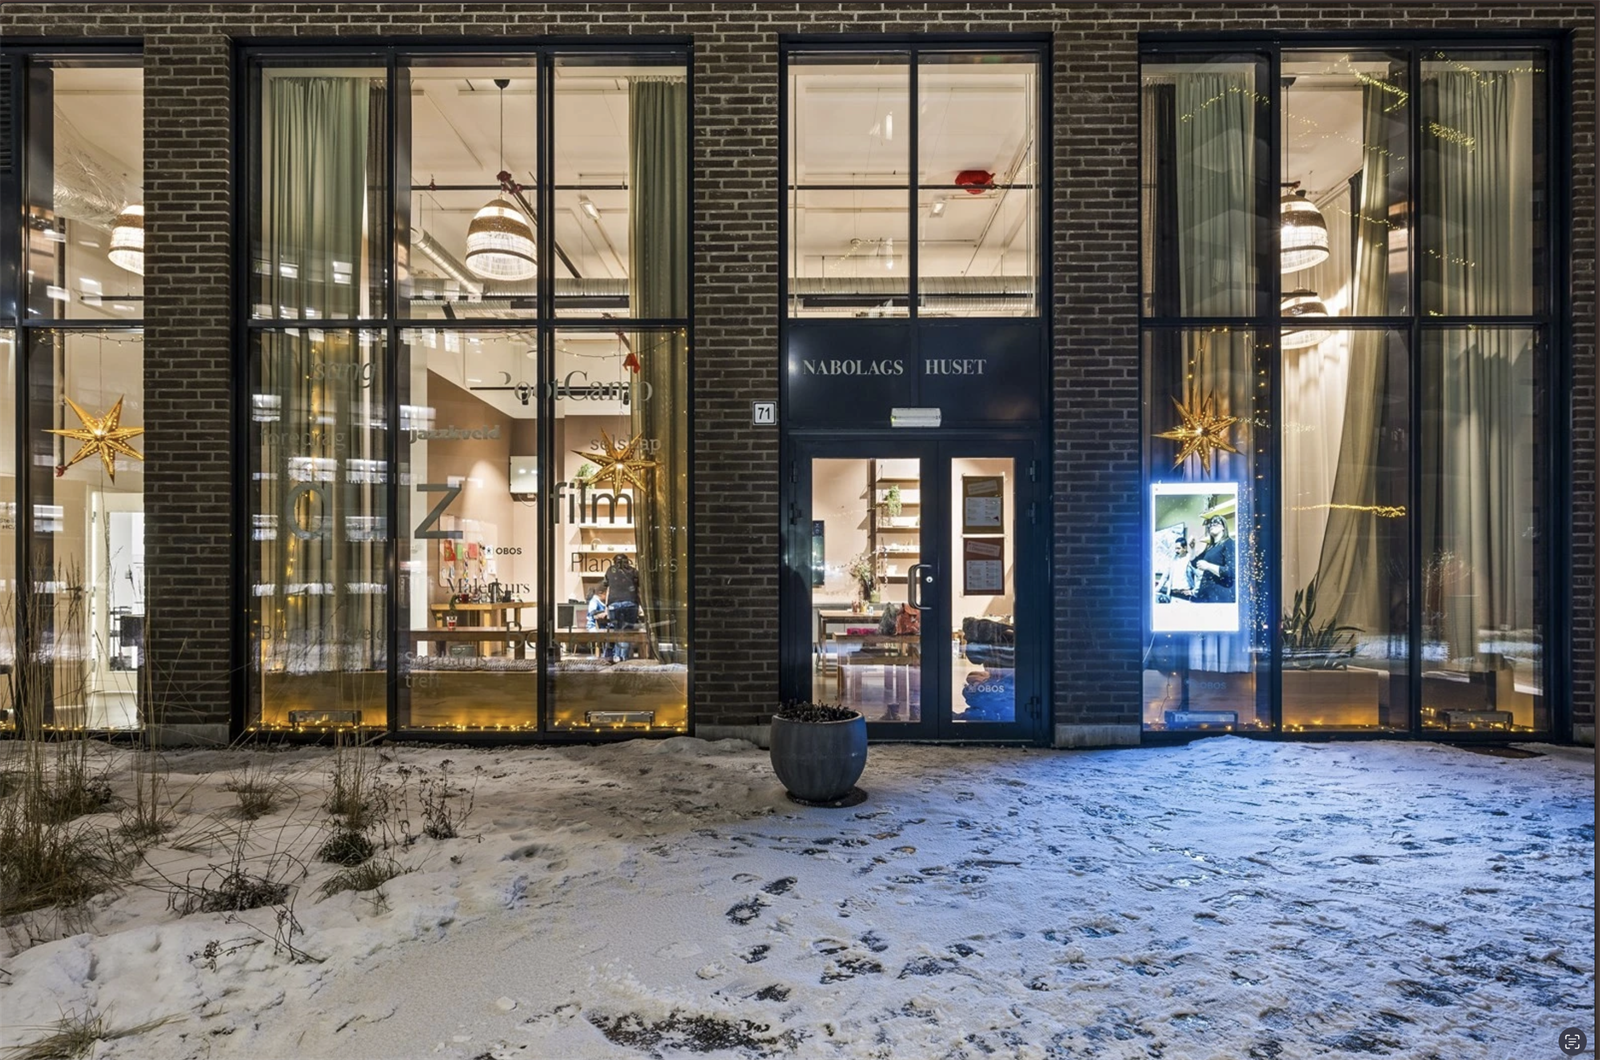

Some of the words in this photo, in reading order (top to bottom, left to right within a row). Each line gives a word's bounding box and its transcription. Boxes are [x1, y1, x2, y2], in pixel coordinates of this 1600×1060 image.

[803, 359, 904, 376] NABOLAGS
[925, 358, 988, 375] HUSET
[758, 407, 770, 420] 71
[410, 424, 500, 444] jazzkveld
[550, 481, 633, 524] film
[495, 547, 522, 556] OBOS
[977, 685, 1005, 693] OBOS
[1200, 681, 1227, 690] OBOS
